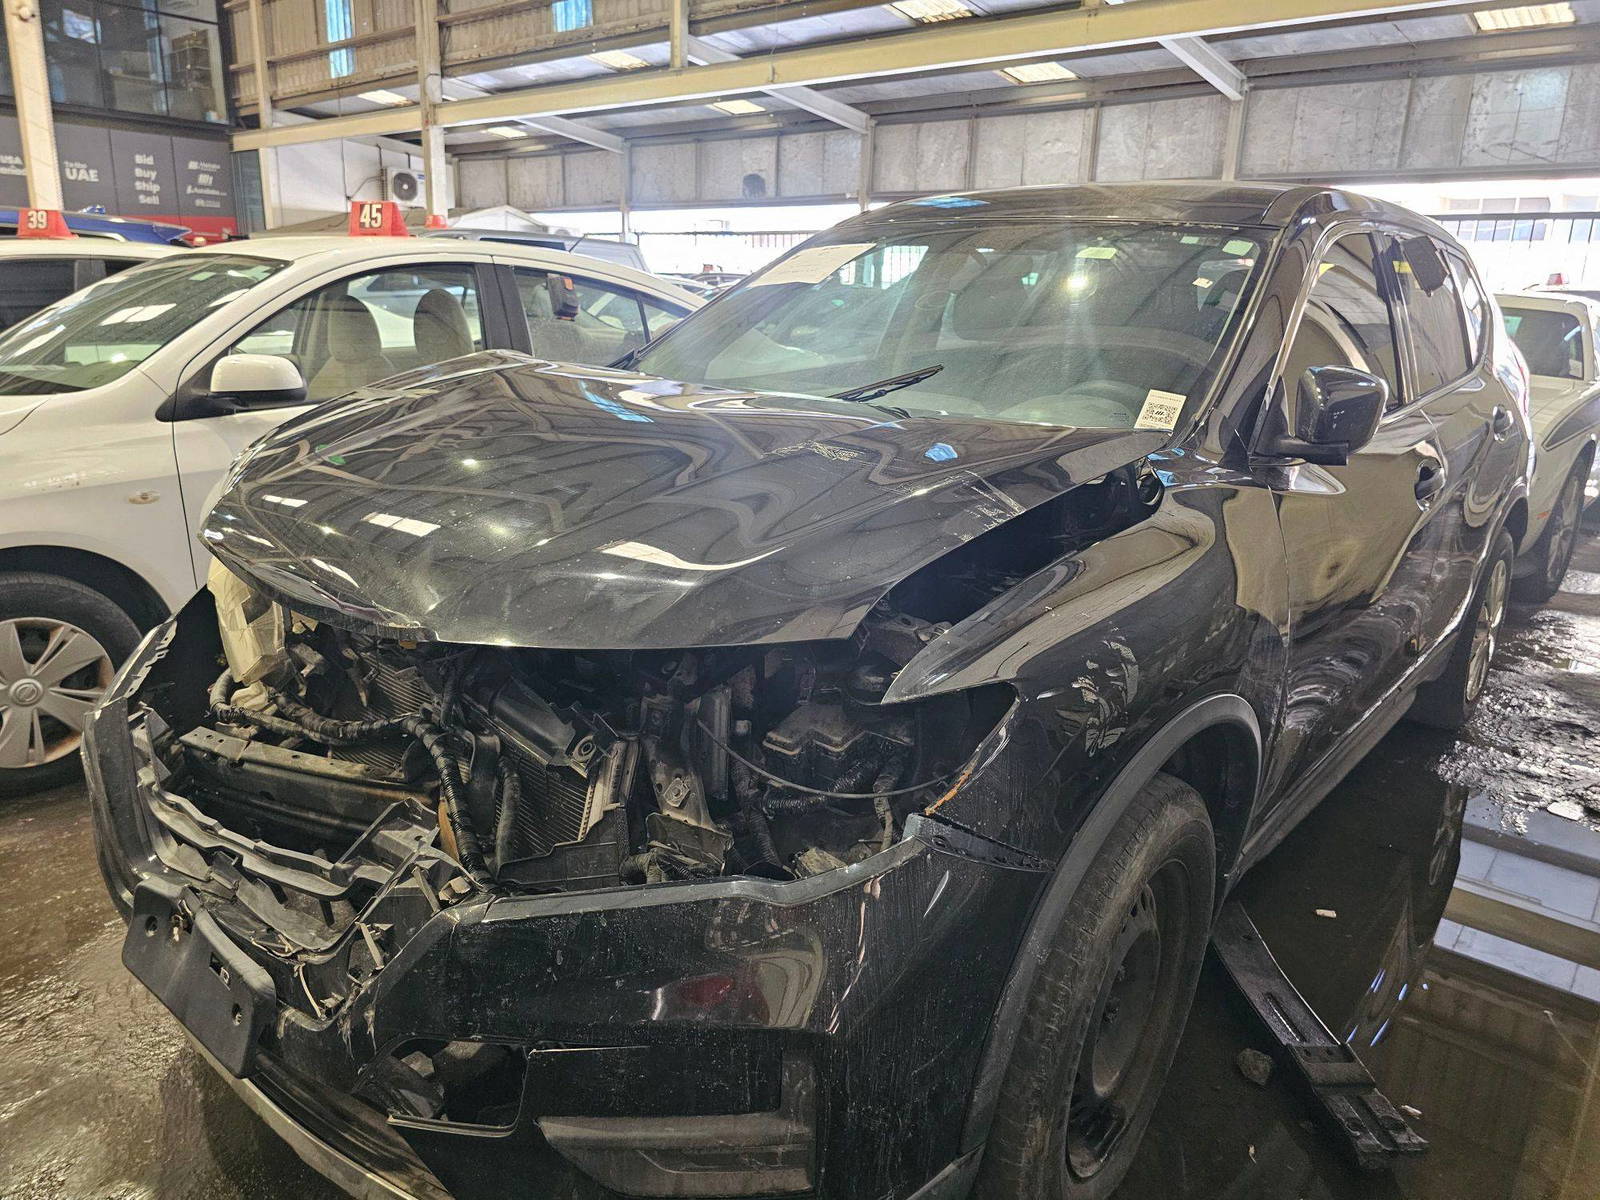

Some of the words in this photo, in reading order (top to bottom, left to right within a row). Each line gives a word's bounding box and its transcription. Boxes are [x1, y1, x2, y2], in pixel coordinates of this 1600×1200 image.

[135, 154, 154, 166] Bid
[65, 168, 99, 182] UAE
[134, 167, 157, 181] Buy
[134, 181, 161, 194] Ship
[138, 194, 160, 205] Sell
[28, 210, 48, 229] 39
[359, 203, 382, 229] 45
